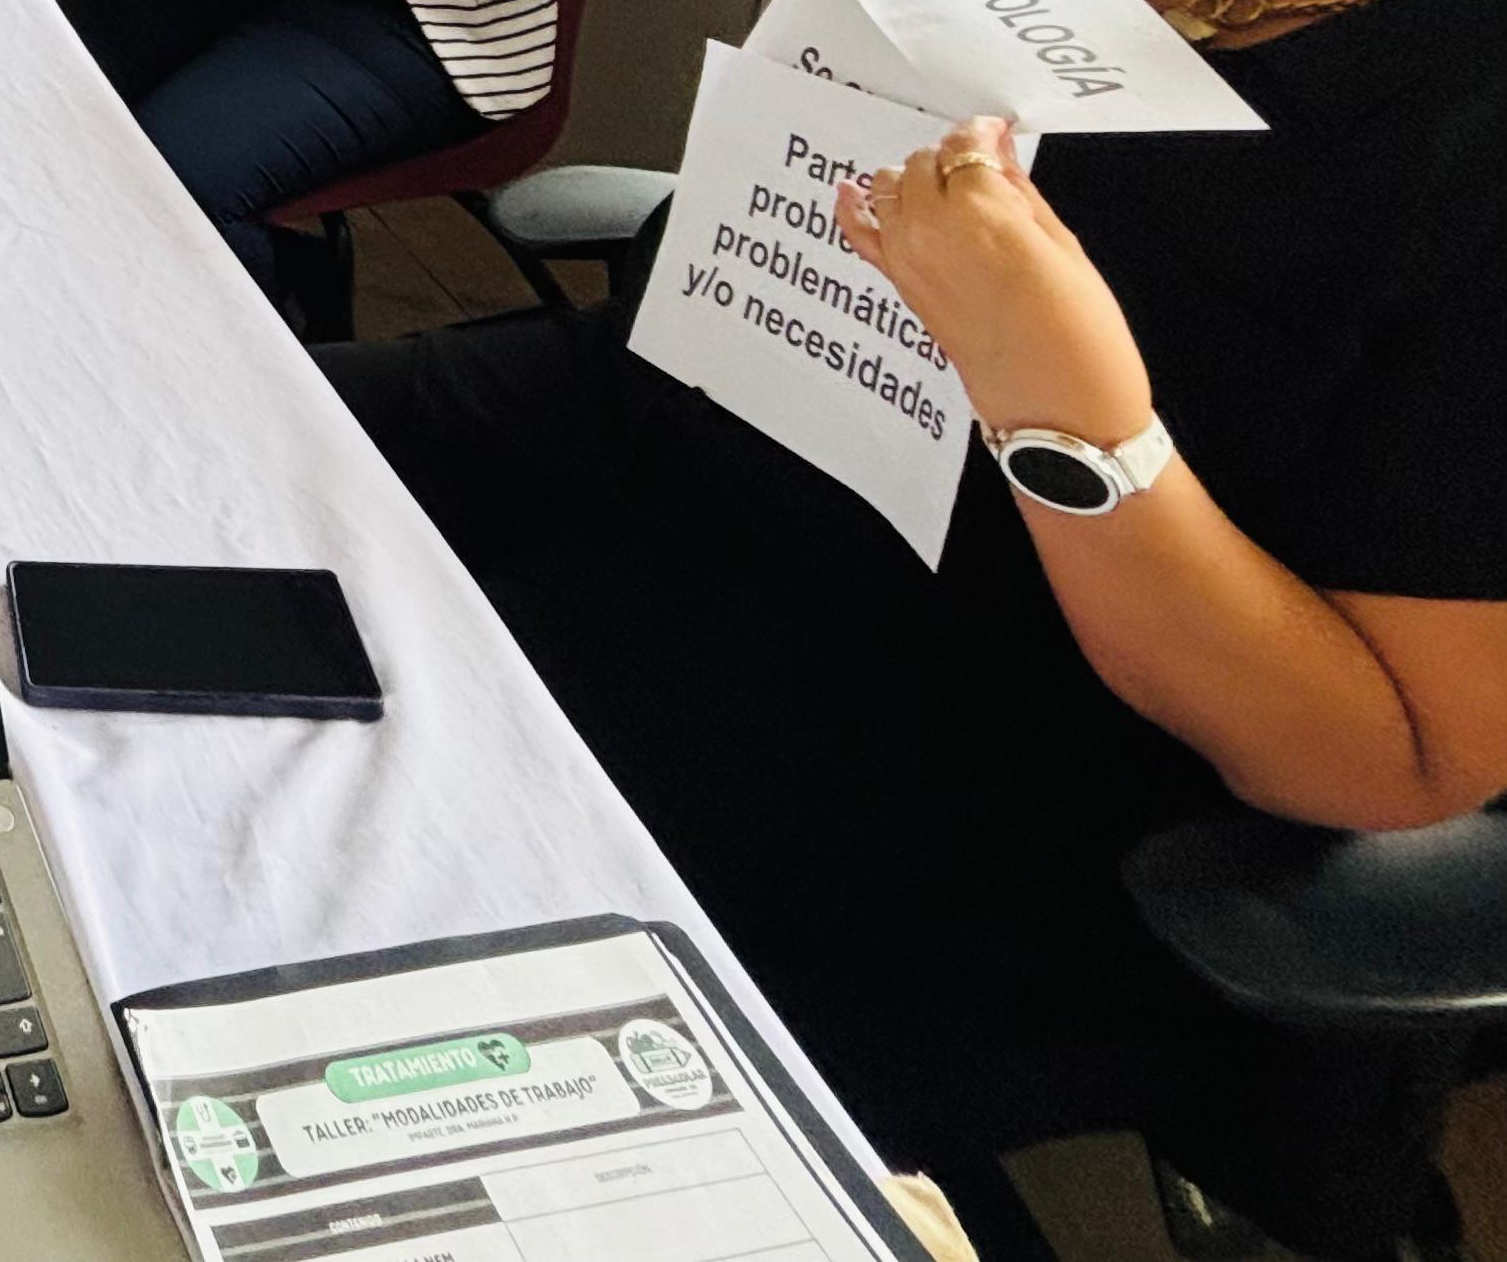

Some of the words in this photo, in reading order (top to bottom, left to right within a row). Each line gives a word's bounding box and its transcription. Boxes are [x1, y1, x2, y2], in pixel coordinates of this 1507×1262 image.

[712, 223, 948, 371] problemáticas
[682, 262, 734, 308] y/o
[742, 294, 946, 441] necesidades
[302, 1117, 373, 1143] TALLER:
[373, 1089, 498, 1131] "MODALIDADES
[501, 1086, 523, 1107] DE
[522, 1074, 597, 1105] TRABAJO"
[348, 1048, 478, 1087] TRATAMIENTO
